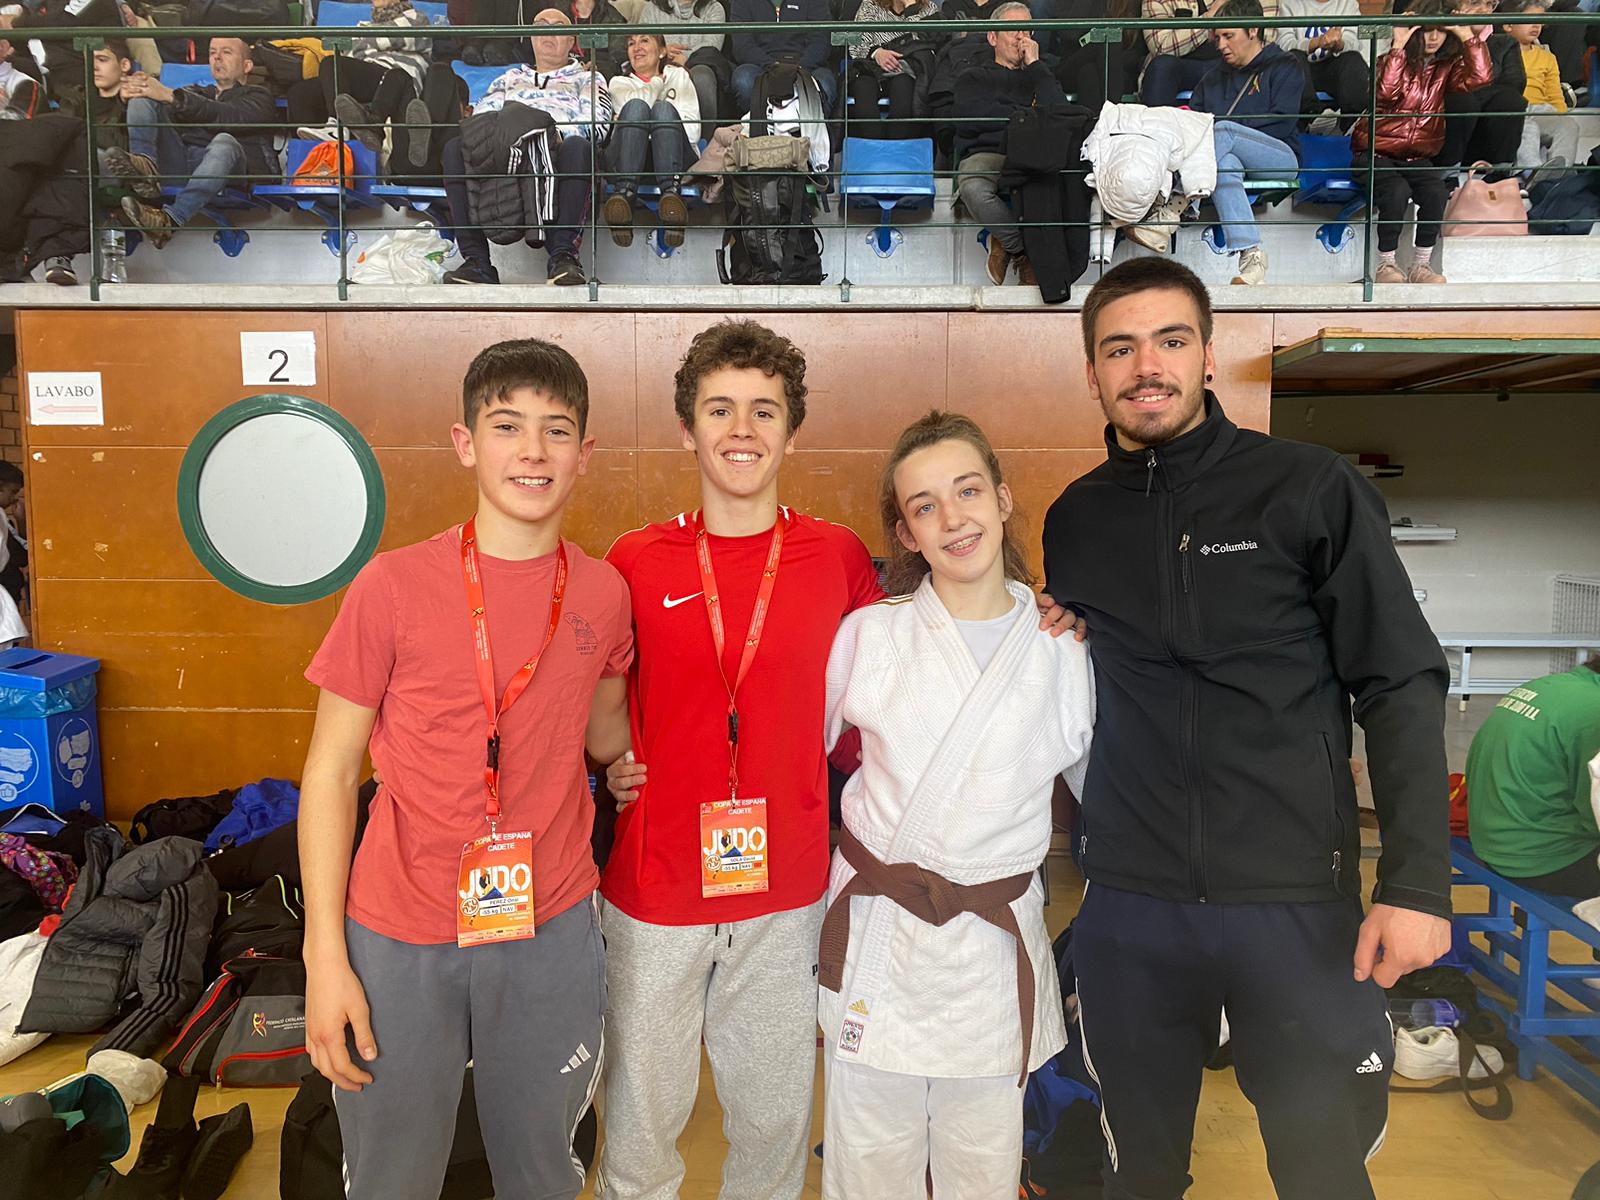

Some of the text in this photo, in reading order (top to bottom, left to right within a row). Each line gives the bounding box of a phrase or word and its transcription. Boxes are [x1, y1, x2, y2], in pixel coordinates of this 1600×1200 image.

[267, 350, 290, 382] 2
[35, 385, 95, 398] LAVABO
[1211, 540, 1258, 554] Columbia
[703, 826, 766, 856] JUDO
[459, 863, 531, 899] JUDO
